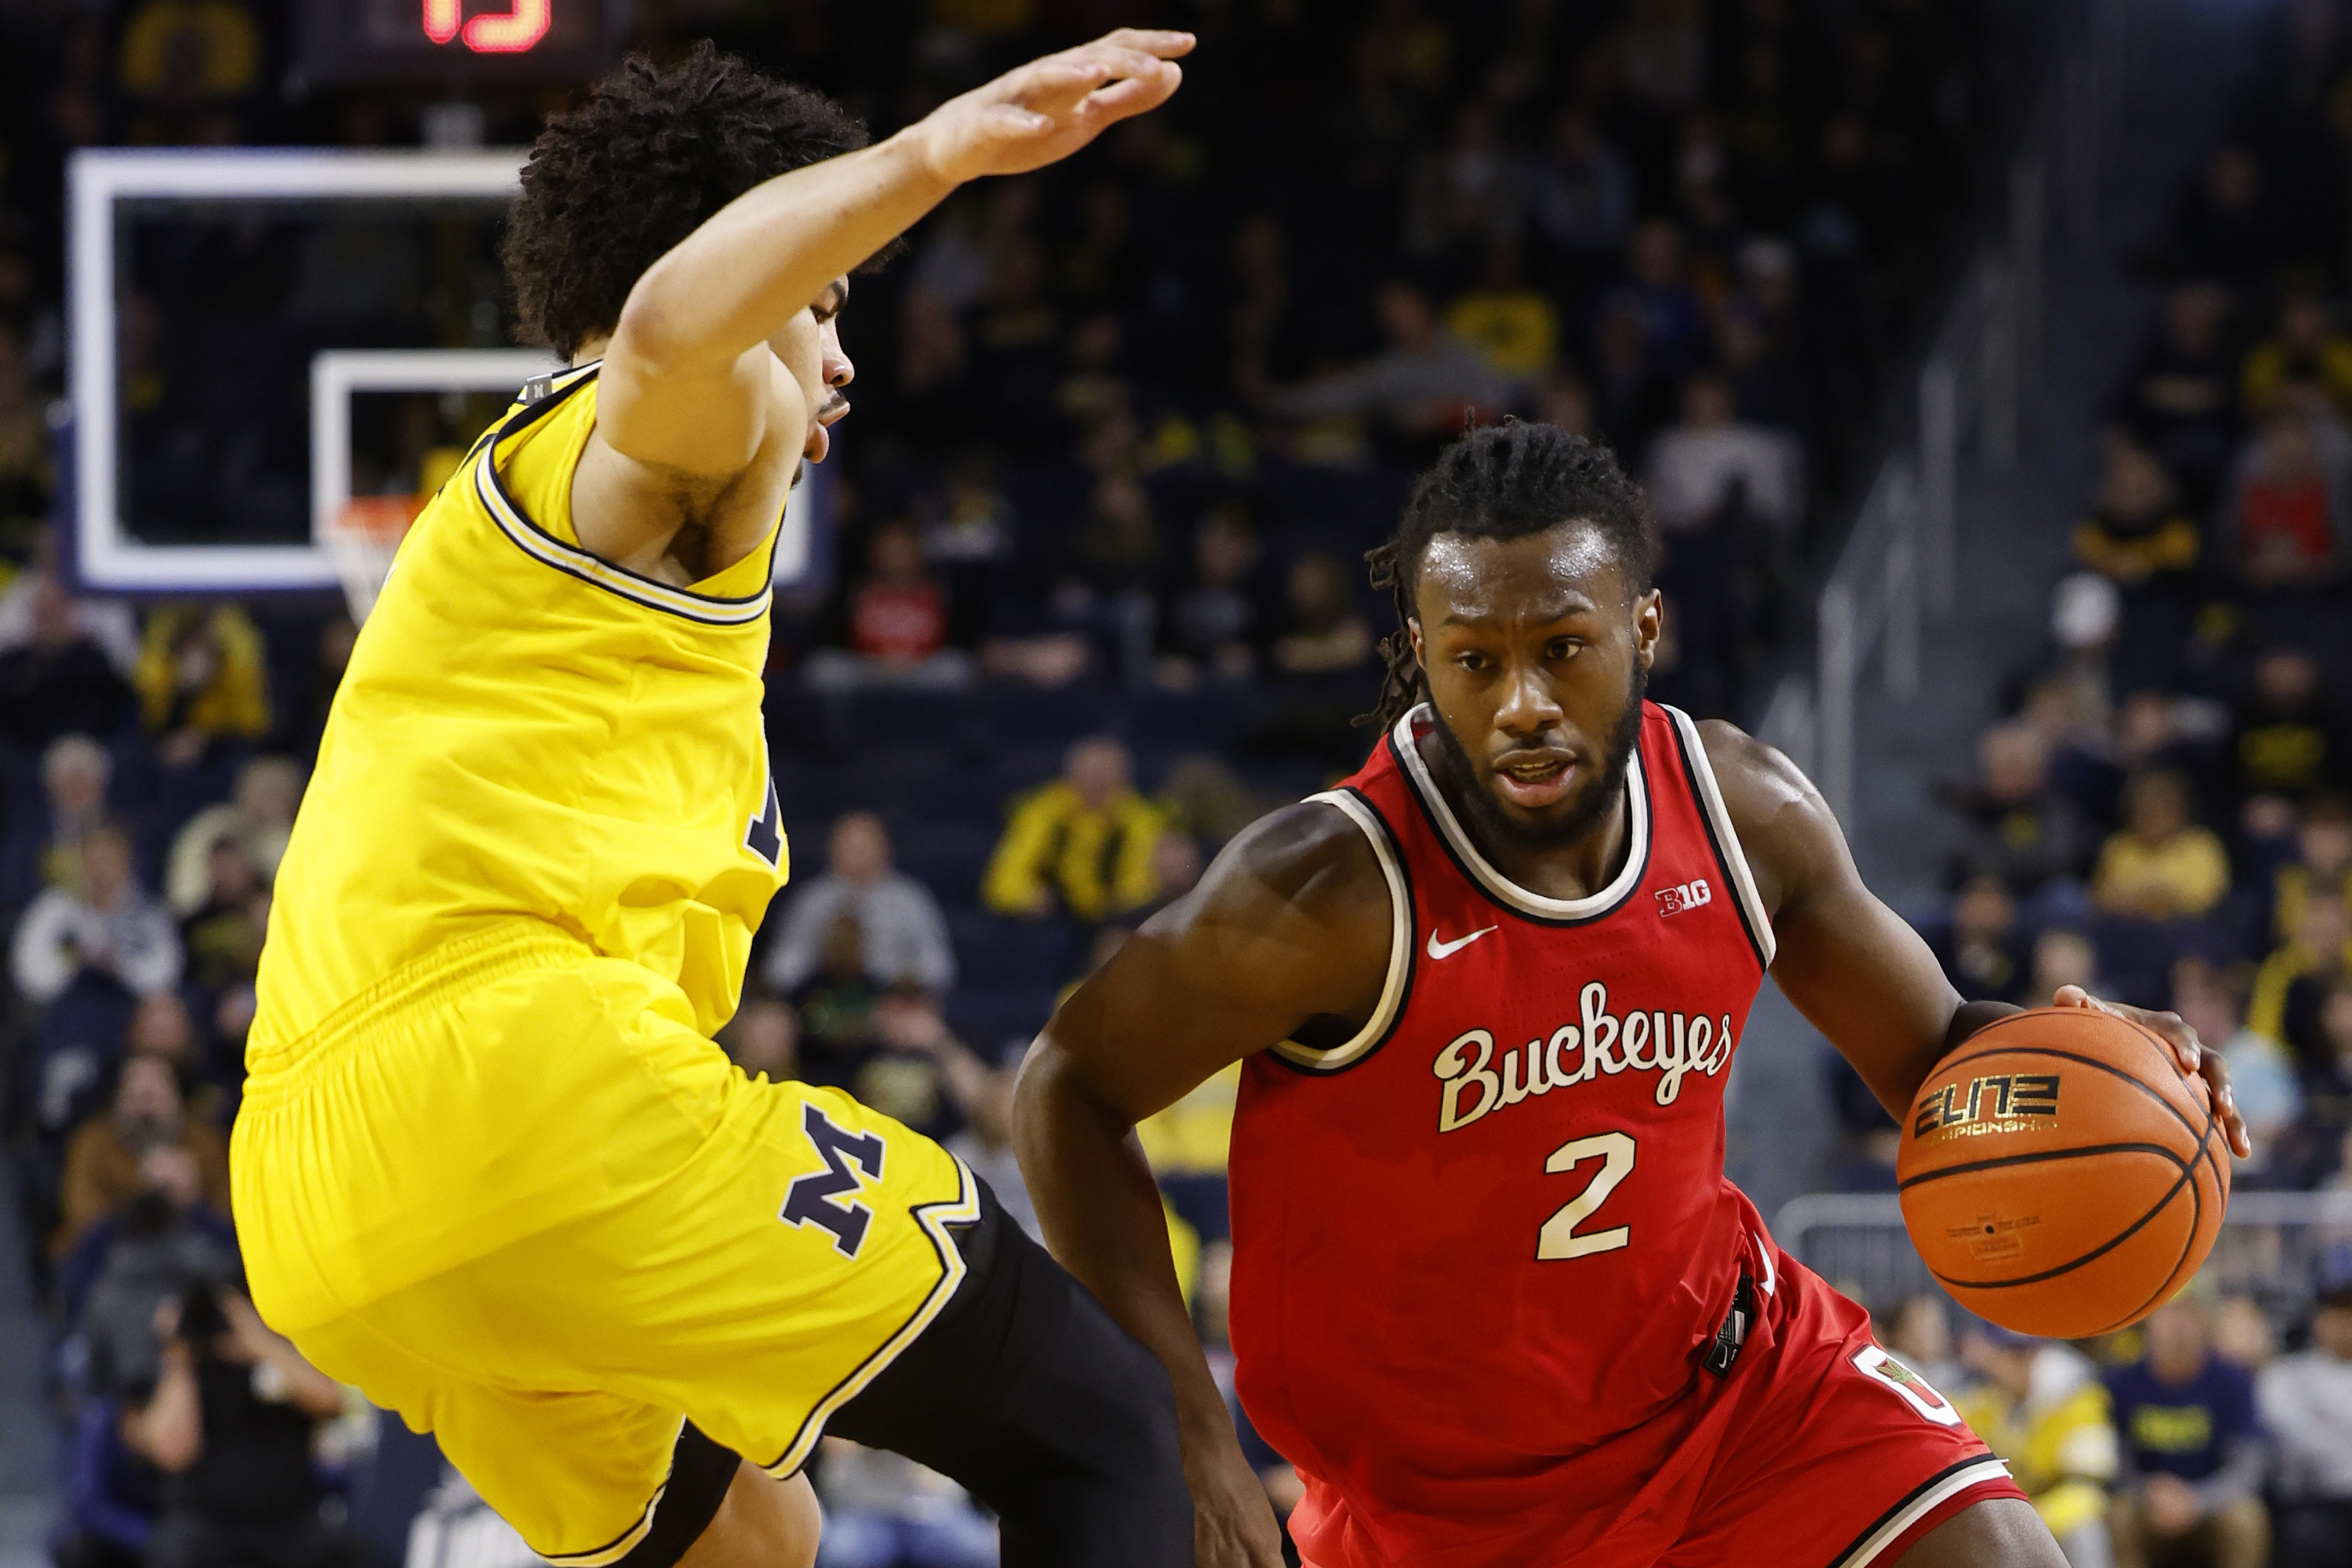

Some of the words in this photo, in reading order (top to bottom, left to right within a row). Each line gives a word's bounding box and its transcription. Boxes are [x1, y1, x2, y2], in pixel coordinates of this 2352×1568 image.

[1432, 981, 1733, 1133] Buckeyes
[1913, 1073, 2060, 1140] ELITE
[778, 1100, 887, 1261] M
[1535, 1132, 1637, 1261] 2
